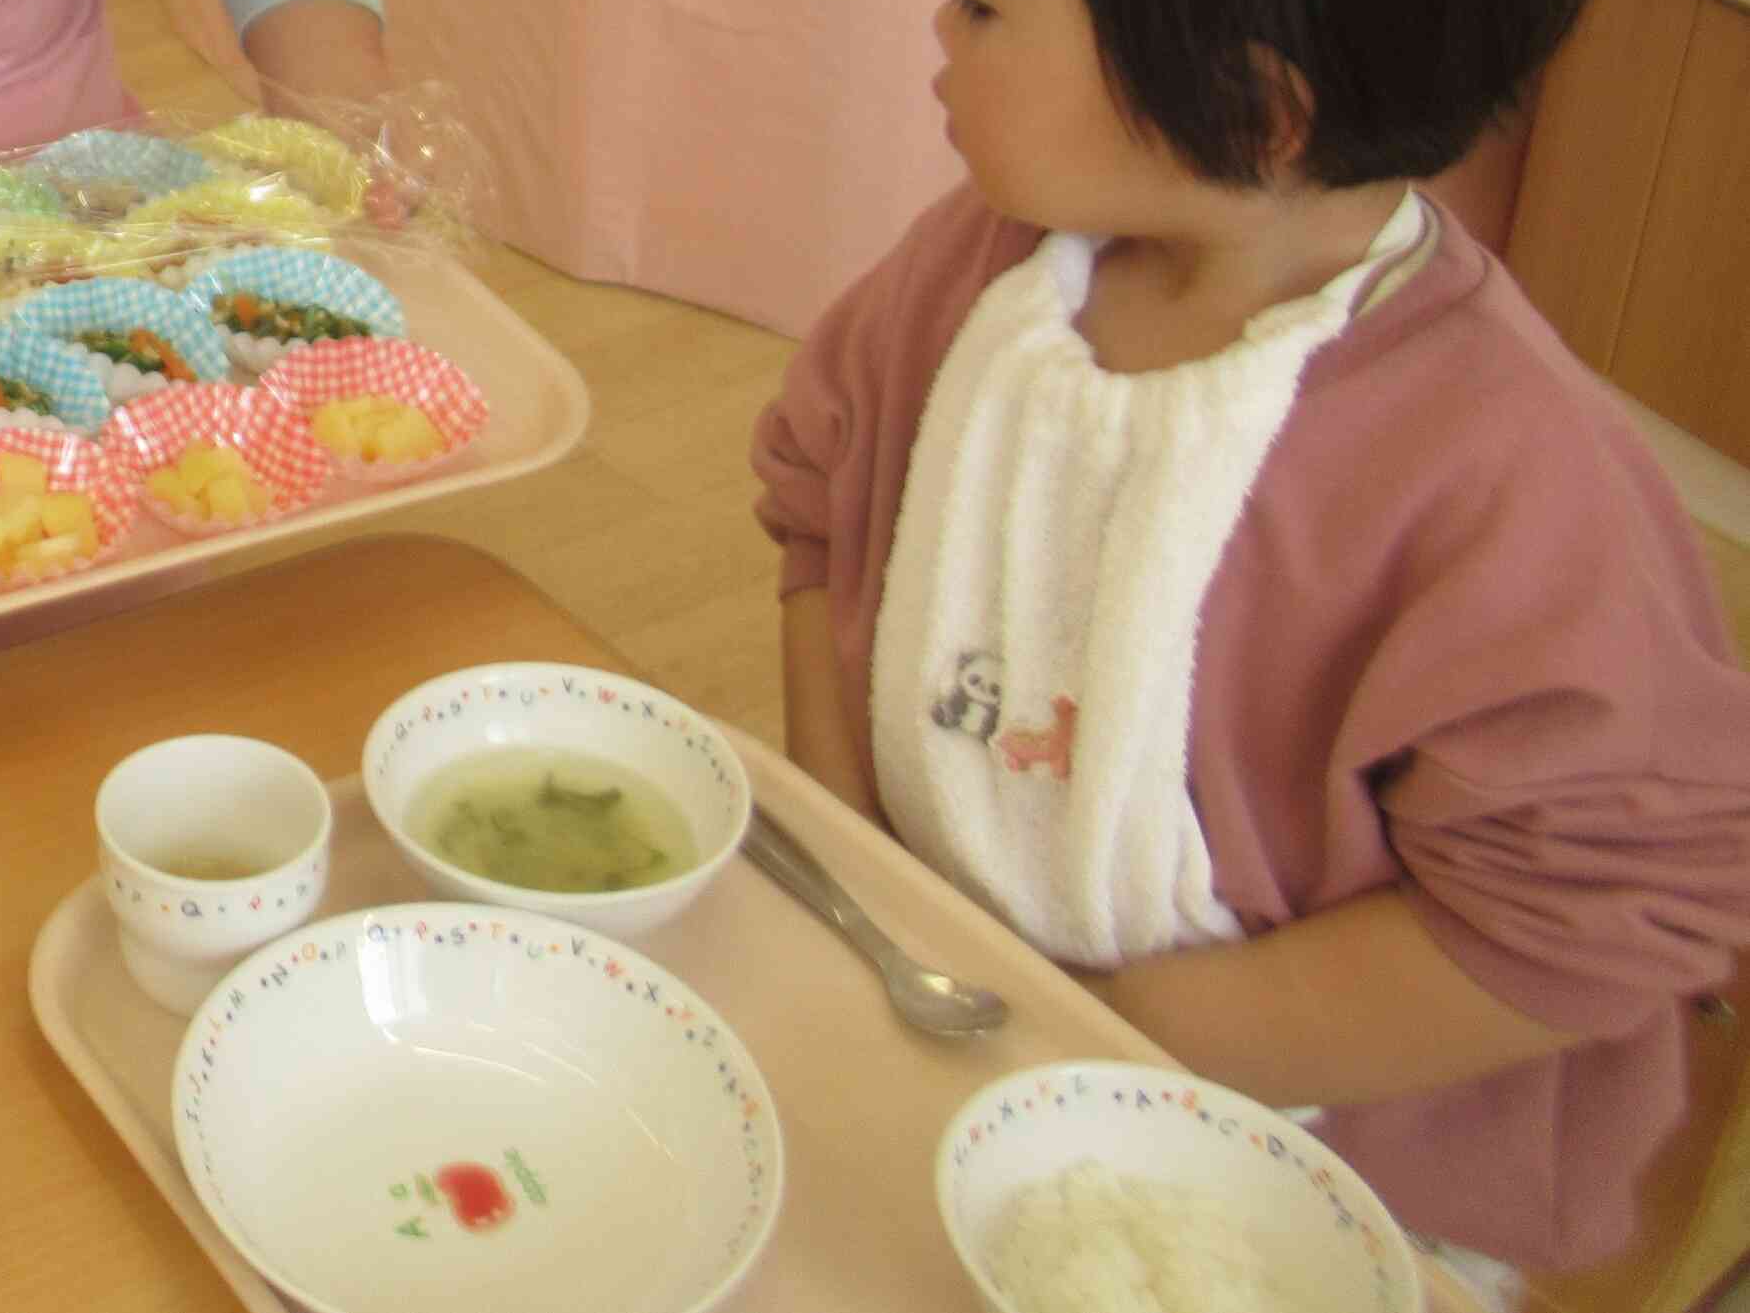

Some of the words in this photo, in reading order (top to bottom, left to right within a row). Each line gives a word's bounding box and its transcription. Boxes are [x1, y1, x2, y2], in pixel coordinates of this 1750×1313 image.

[561, 675, 574, 694] V
[641, 700, 655, 720] X
[180, 900, 203, 918] Q
[270, 961, 291, 988] N
[367, 924, 389, 943] Q
[570, 935, 587, 956] V
[644, 980, 661, 1005] X
[996, 1097, 1017, 1122] X
[1135, 1088, 1153, 1112] A
[1217, 1117, 1240, 1137] C
[1266, 1134, 1287, 1159] D
